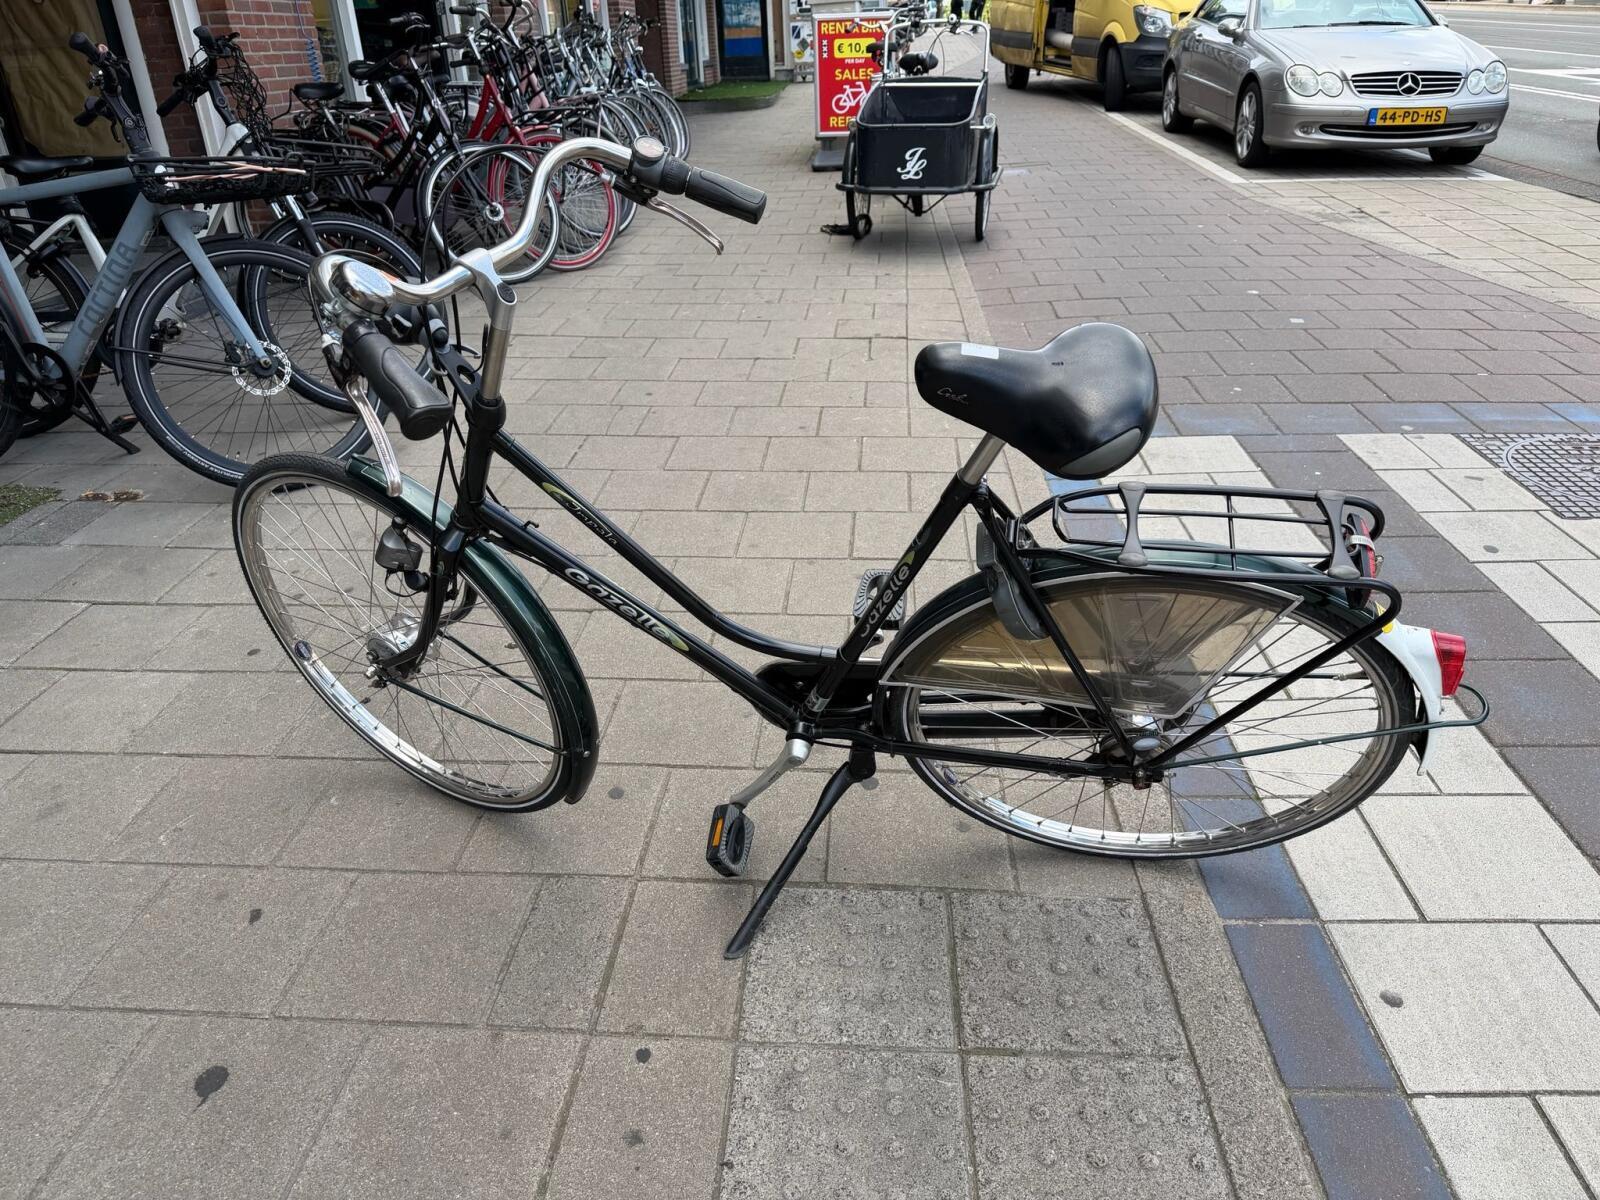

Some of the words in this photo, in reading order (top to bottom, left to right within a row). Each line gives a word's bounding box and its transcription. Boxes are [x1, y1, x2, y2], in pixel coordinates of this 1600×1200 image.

[835, 68, 874, 80] SALES
[1380, 110, 1442, 123] 44-PD-HS
[78, 242, 137, 336] CORTINA
[565, 568, 669, 640] Gazelle
